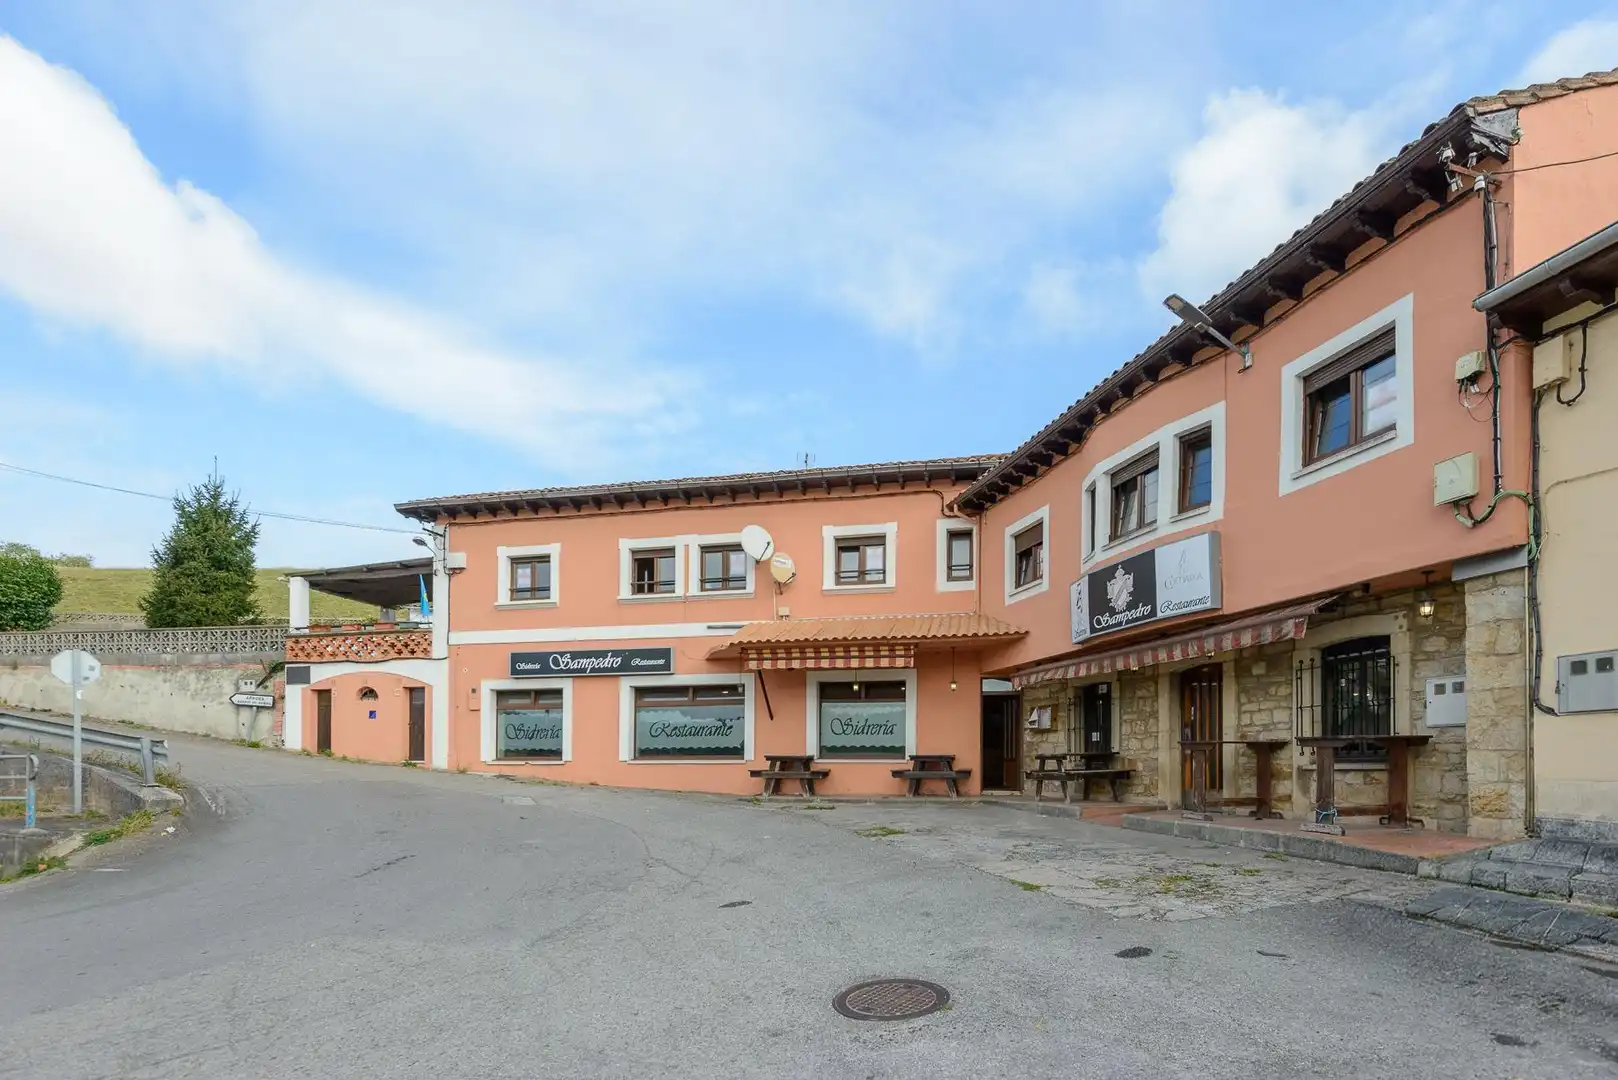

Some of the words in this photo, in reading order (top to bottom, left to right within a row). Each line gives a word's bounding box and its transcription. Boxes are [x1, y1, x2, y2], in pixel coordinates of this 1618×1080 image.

[1160, 595, 1210, 613] Restaurante
[1093, 602, 1152, 629] Sampedro
[549, 652, 623, 673] Sampedro
[650, 719, 733, 738] Restaurante
[830, 717, 897, 736] Sidrería
